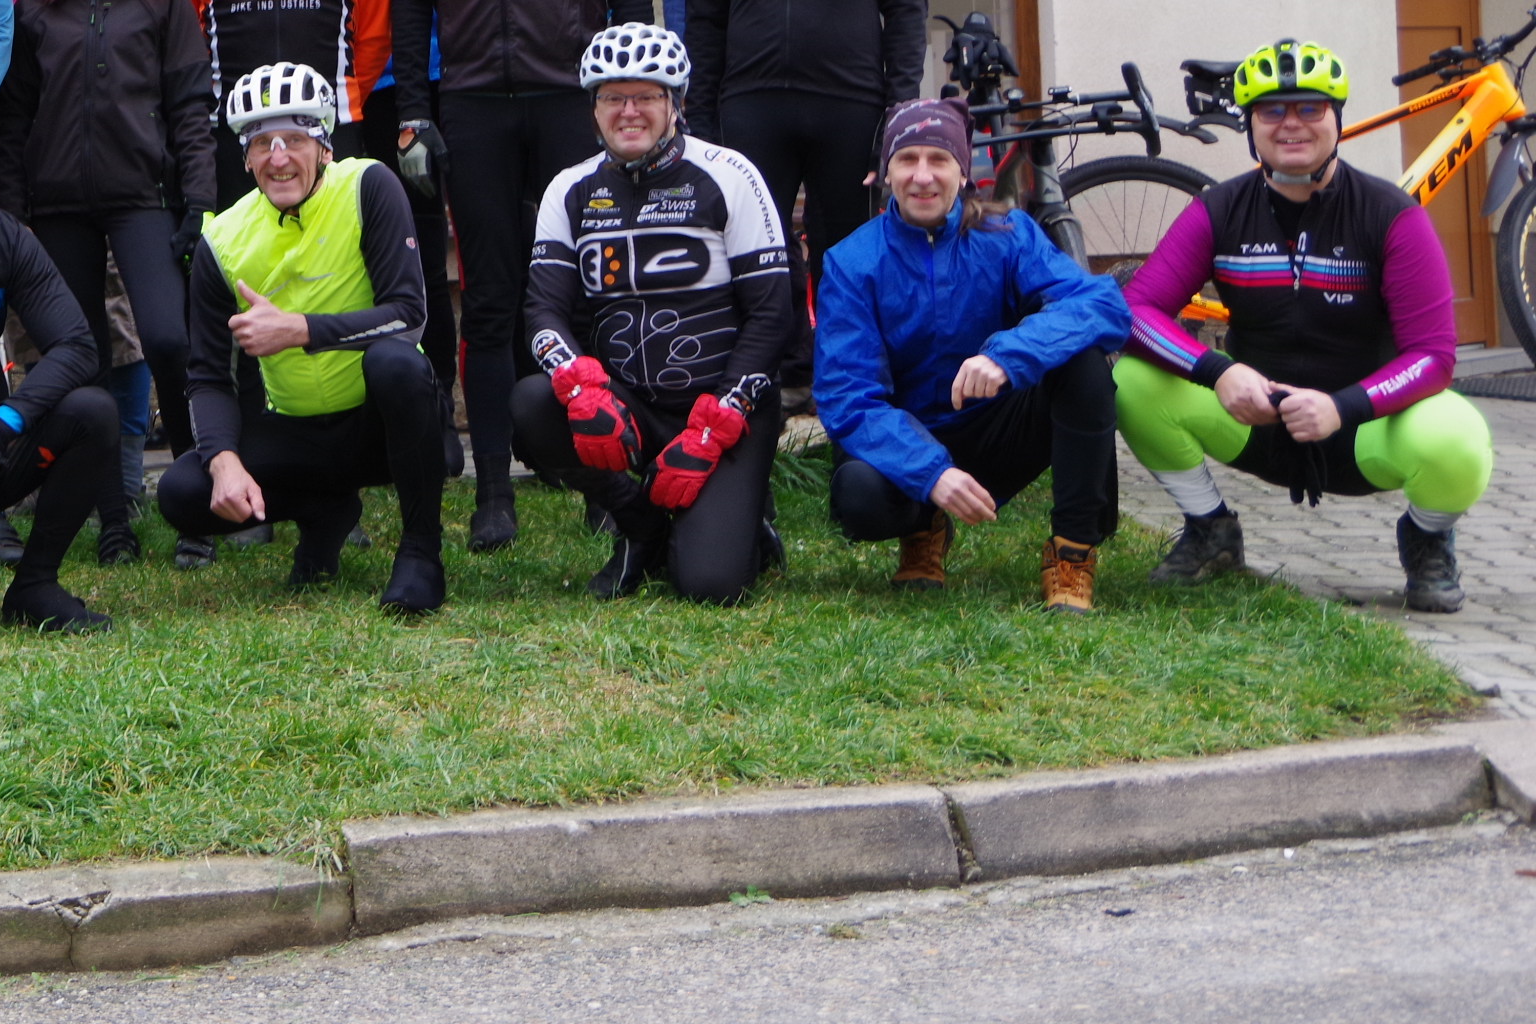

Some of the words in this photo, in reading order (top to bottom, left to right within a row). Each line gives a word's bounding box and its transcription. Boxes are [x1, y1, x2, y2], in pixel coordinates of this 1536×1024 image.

[230, 0, 253, 13] BIKE
[639, 202, 660, 214] DT
[660, 199, 697, 211] SWISS
[726, 156, 776, 245] ELETTROVENETA
[1240, 242, 1278, 255] TAM
[1323, 291, 1354, 304] VIP
